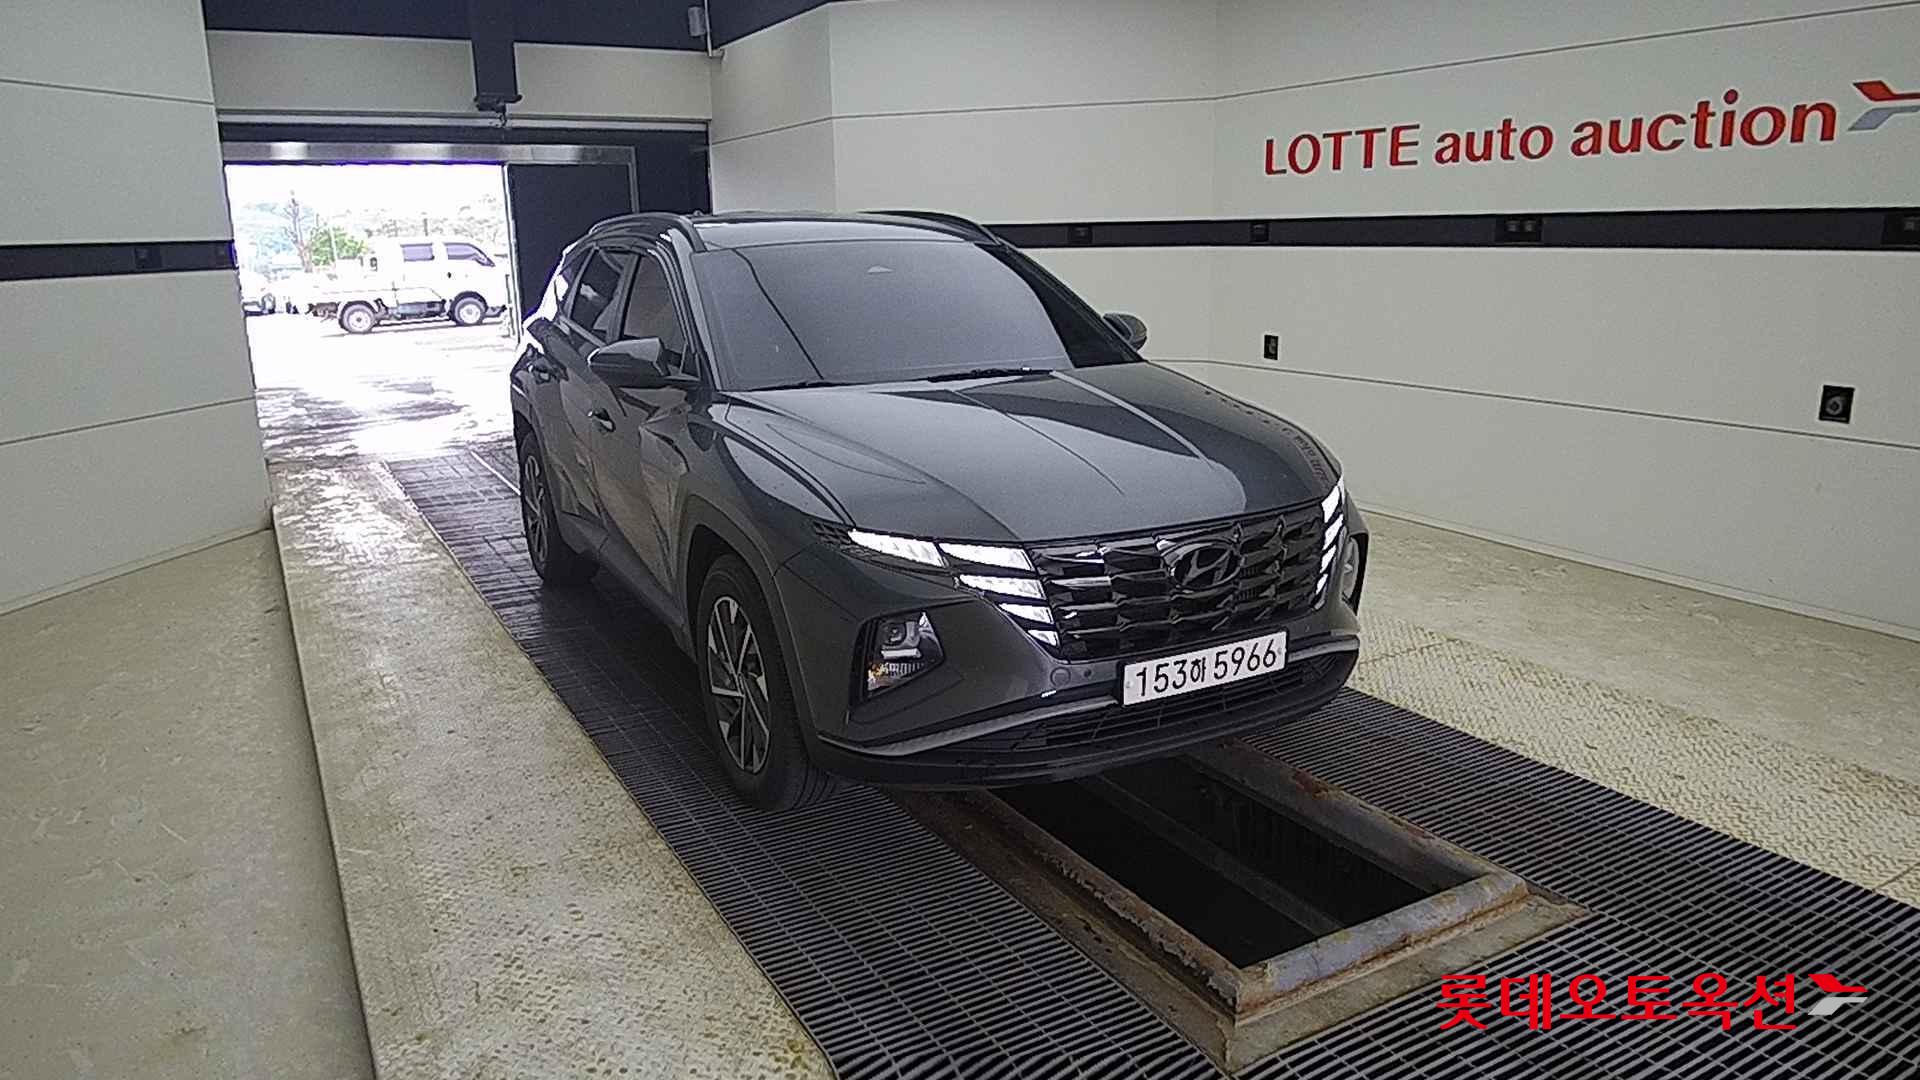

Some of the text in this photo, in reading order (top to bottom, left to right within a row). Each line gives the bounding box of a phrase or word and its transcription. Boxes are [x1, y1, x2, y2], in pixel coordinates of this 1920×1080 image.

[1264, 89, 1837, 175] LOTTE auto auction
[1136, 638, 1277, 697] 153하 5966
